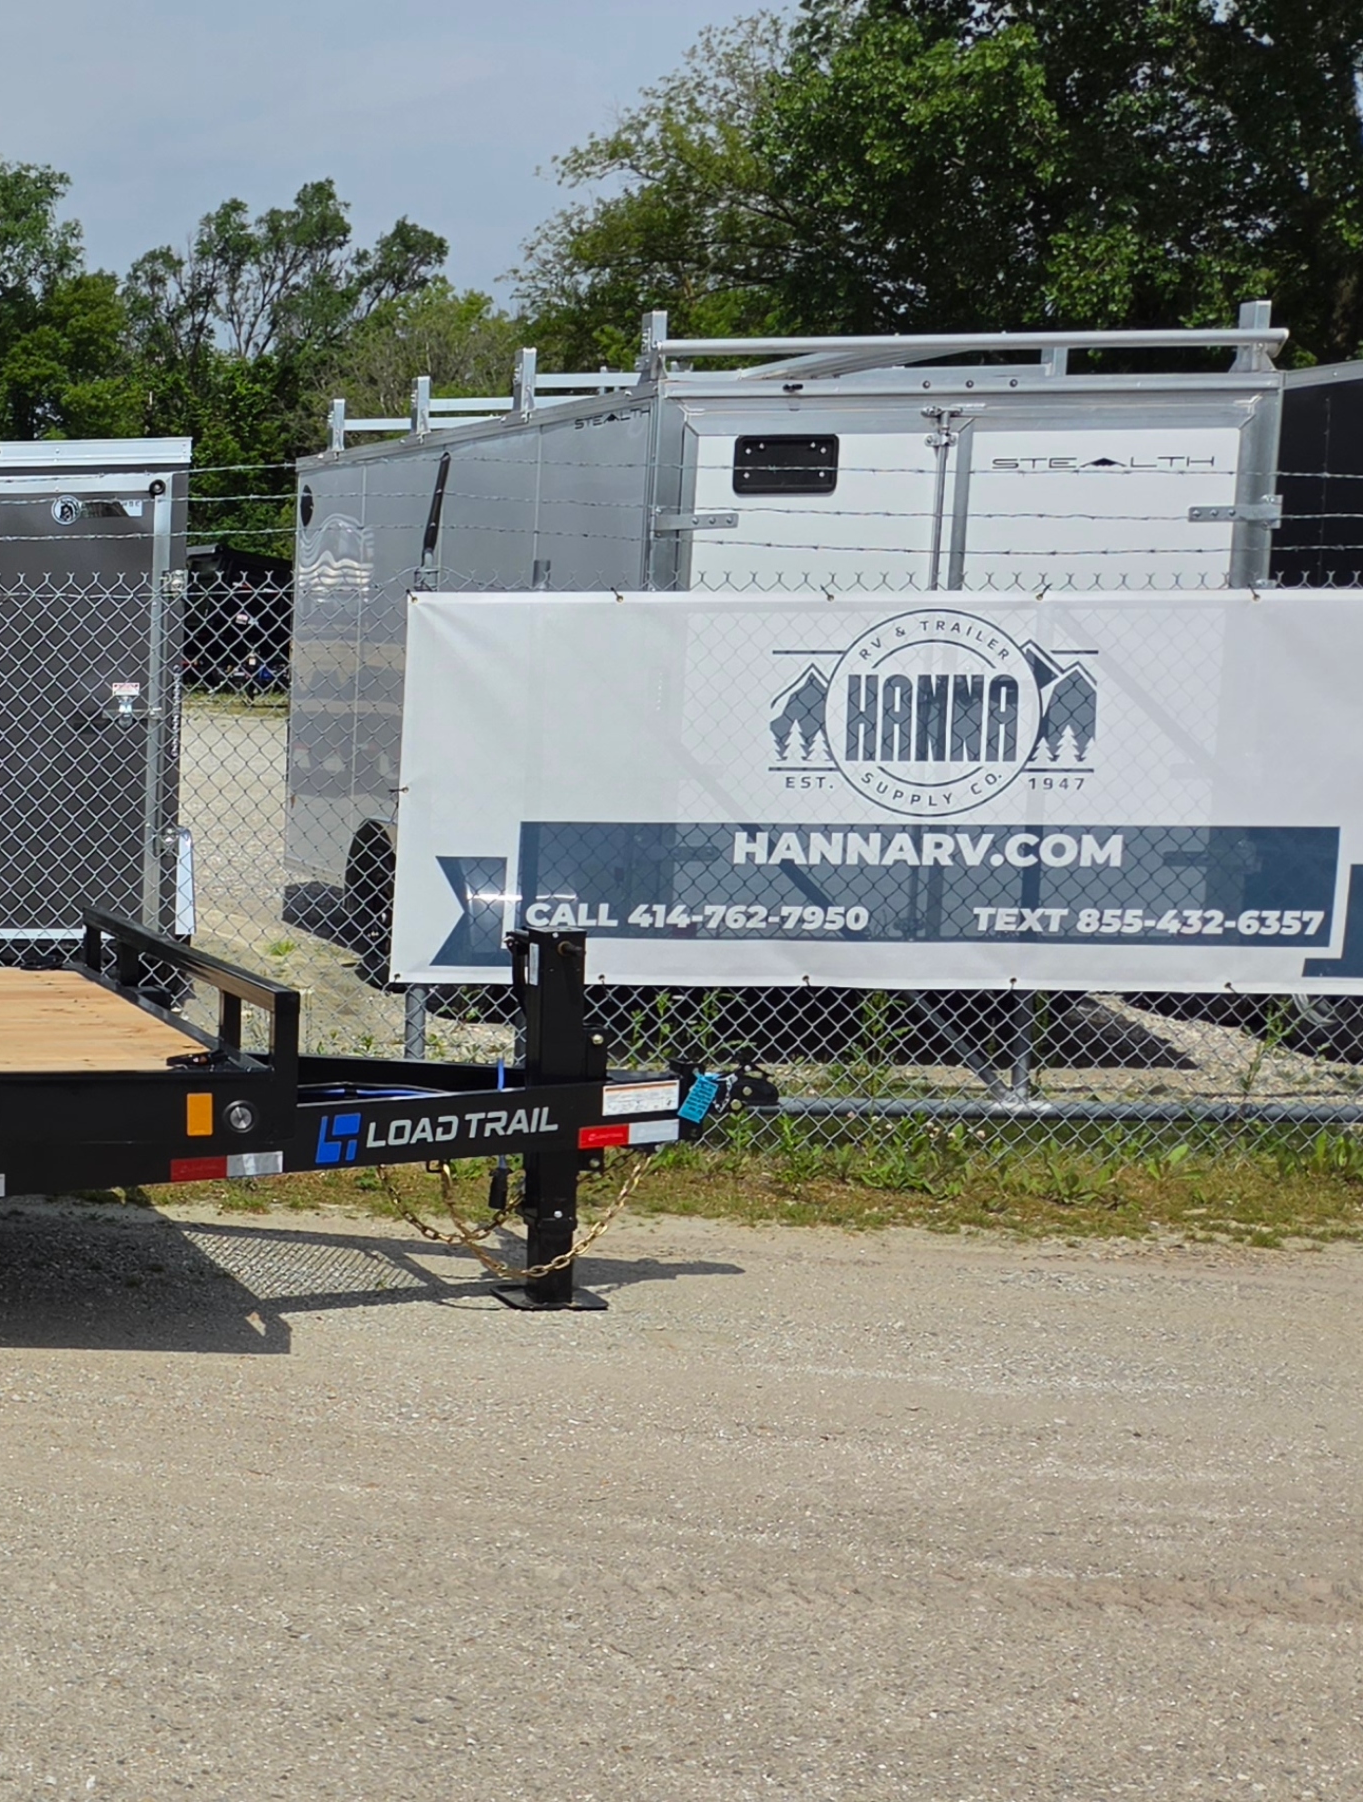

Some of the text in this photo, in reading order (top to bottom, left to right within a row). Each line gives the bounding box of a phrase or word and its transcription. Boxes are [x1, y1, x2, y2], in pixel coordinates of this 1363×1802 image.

[574, 406, 651, 430] STEALTH
[992, 456, 1214, 470] STEALTH
[859, 620, 1010, 660] RV & TRAILER
[845, 673, 1019, 762] HANNA
[785, 776, 834, 789] EST.
[861, 772, 1003, 807] SUPPLY CO.
[1028, 777, 1085, 790] 1947
[732, 831, 1123, 868] HANNARV.COM
[525, 903, 869, 931] CALL 414-762-7950
[973, 907, 1324, 936] TEXT 855-432-6357
[366, 1107, 559, 1148] LOAD TRAIL
